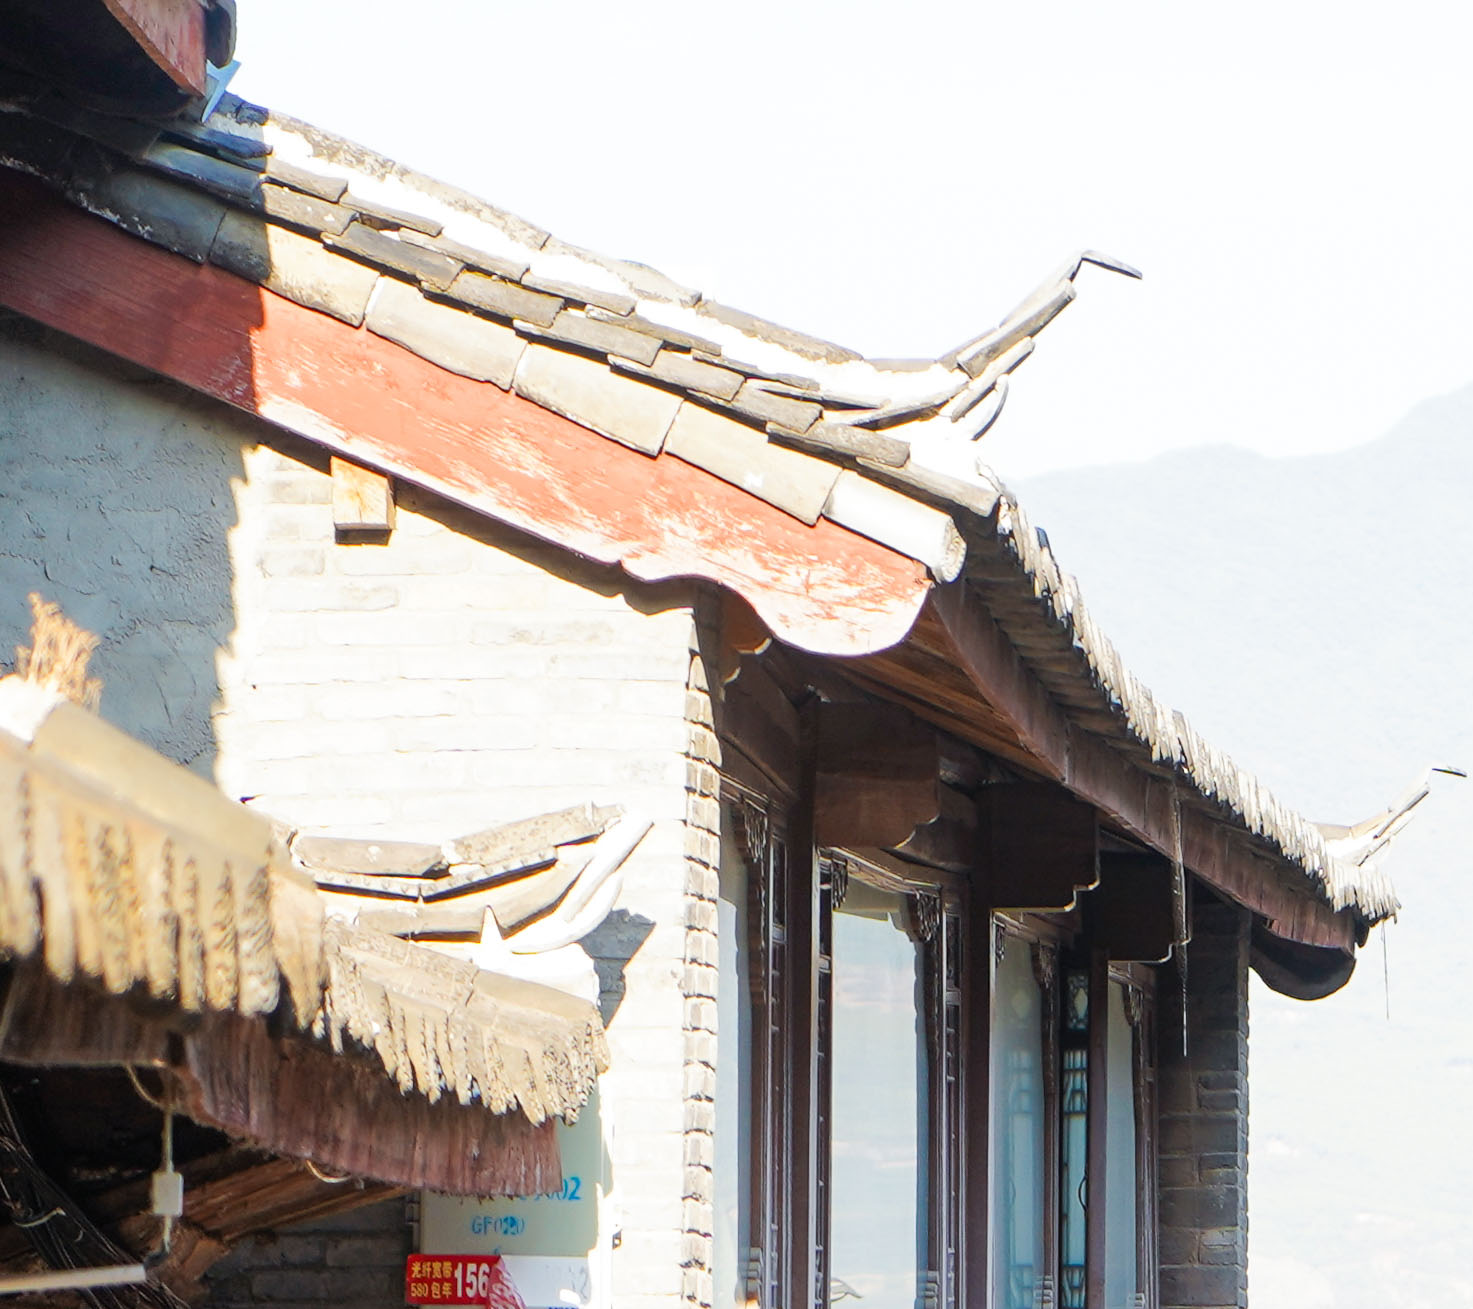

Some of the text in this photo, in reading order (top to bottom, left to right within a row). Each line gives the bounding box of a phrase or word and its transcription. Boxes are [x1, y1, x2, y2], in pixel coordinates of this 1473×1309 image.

[411, 1260, 454, 1279] 光纤宽带
[410, 1281, 453, 1299] 580 包年
